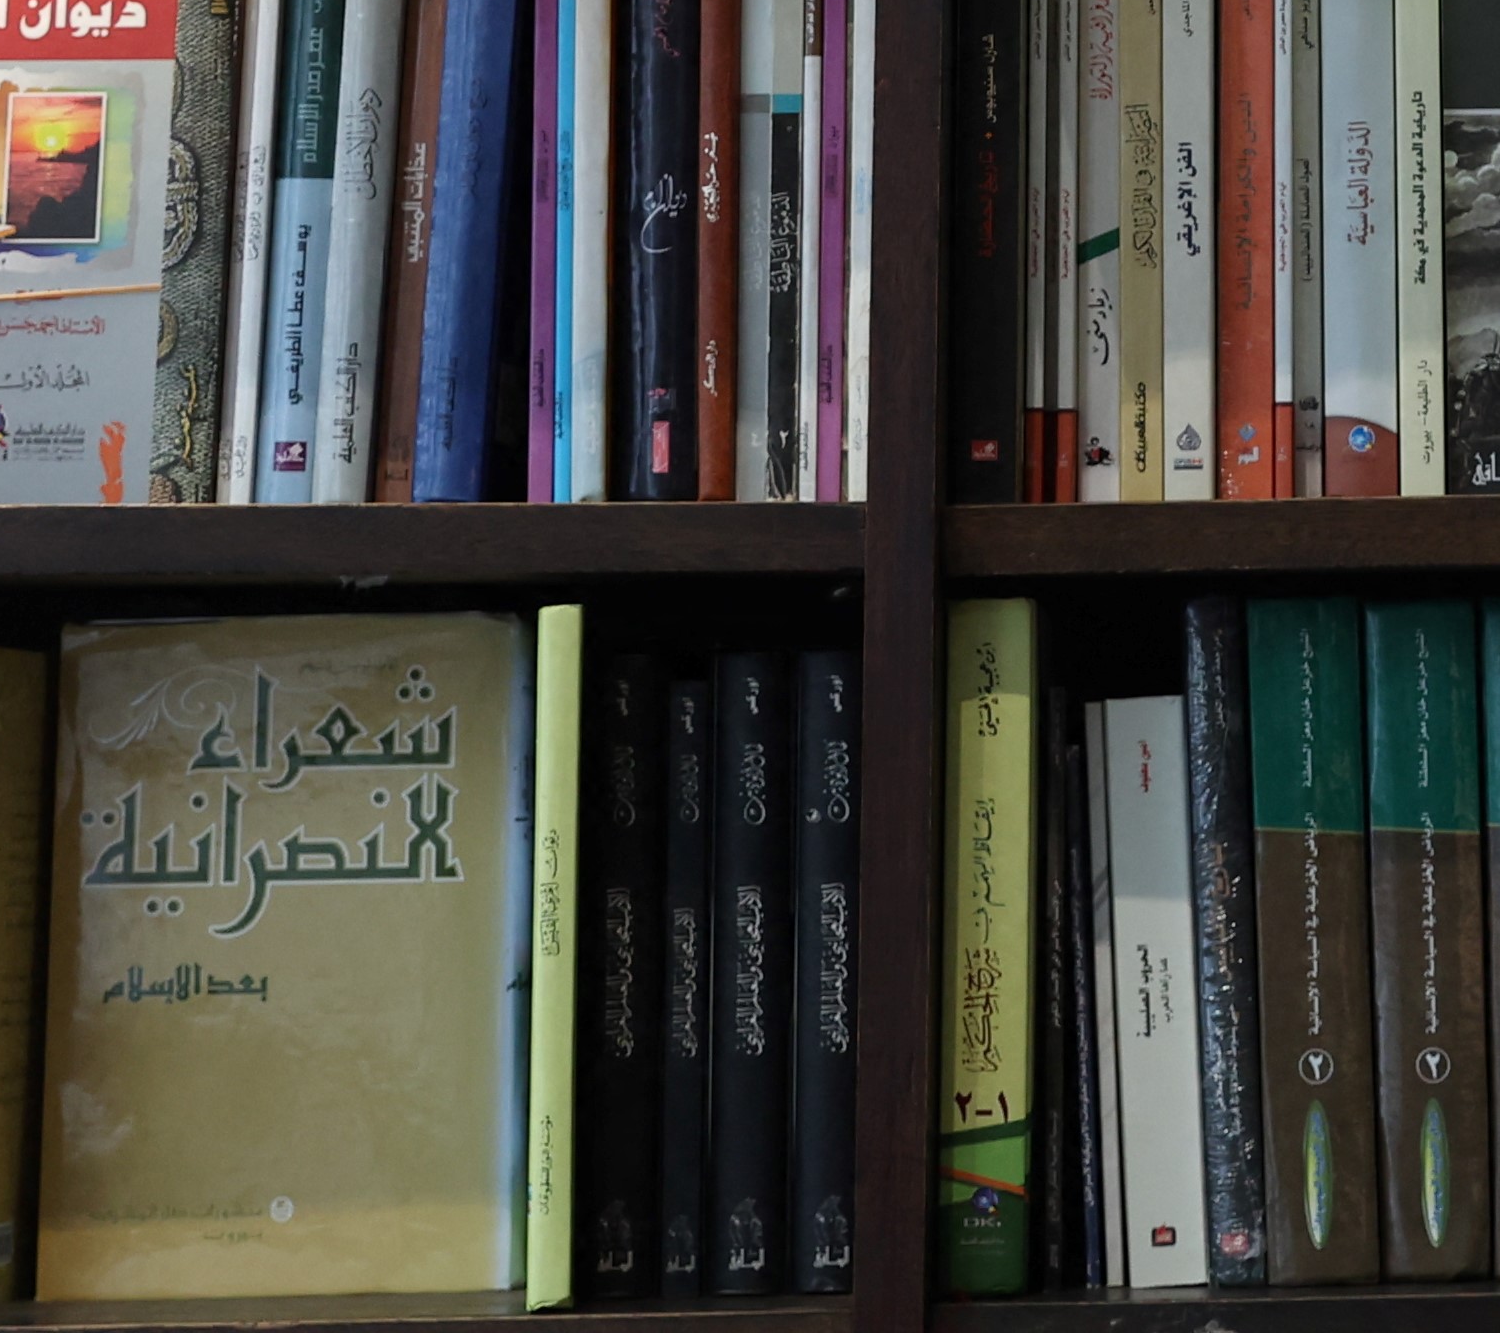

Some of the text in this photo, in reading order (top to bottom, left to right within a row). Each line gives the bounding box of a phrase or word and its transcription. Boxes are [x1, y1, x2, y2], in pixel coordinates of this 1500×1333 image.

[302, 23, 326, 70] عصر
[300, 65, 325, 101] صدر
[1410, 89, 1427, 139] تاريخية
[1410, 141, 1427, 181] الدعوة
[1175, 141, 1201, 257] الفن الإغريقي
[1345, 119, 1375, 246] الدولة العباسية
[401, 141, 429, 263] عذابات المتنبي
[1412, 237, 1429, 255] في
[1413, 257, 1427, 284] مكة
[284, 223, 312, 406] يوسف عطا الطريفي
[1087, 287, 1113, 320] زياد
[335, 340, 362, 368] دار
[1415, 358, 1433, 377] دار
[1421, 429, 1435, 465] بيروت
[188, 664, 459, 790] شعراء
[1135, 943, 1153, 985] الحروب
[206, 972, 269, 1003] بعد
[1425, 1051, 1441, 1080] ٢
